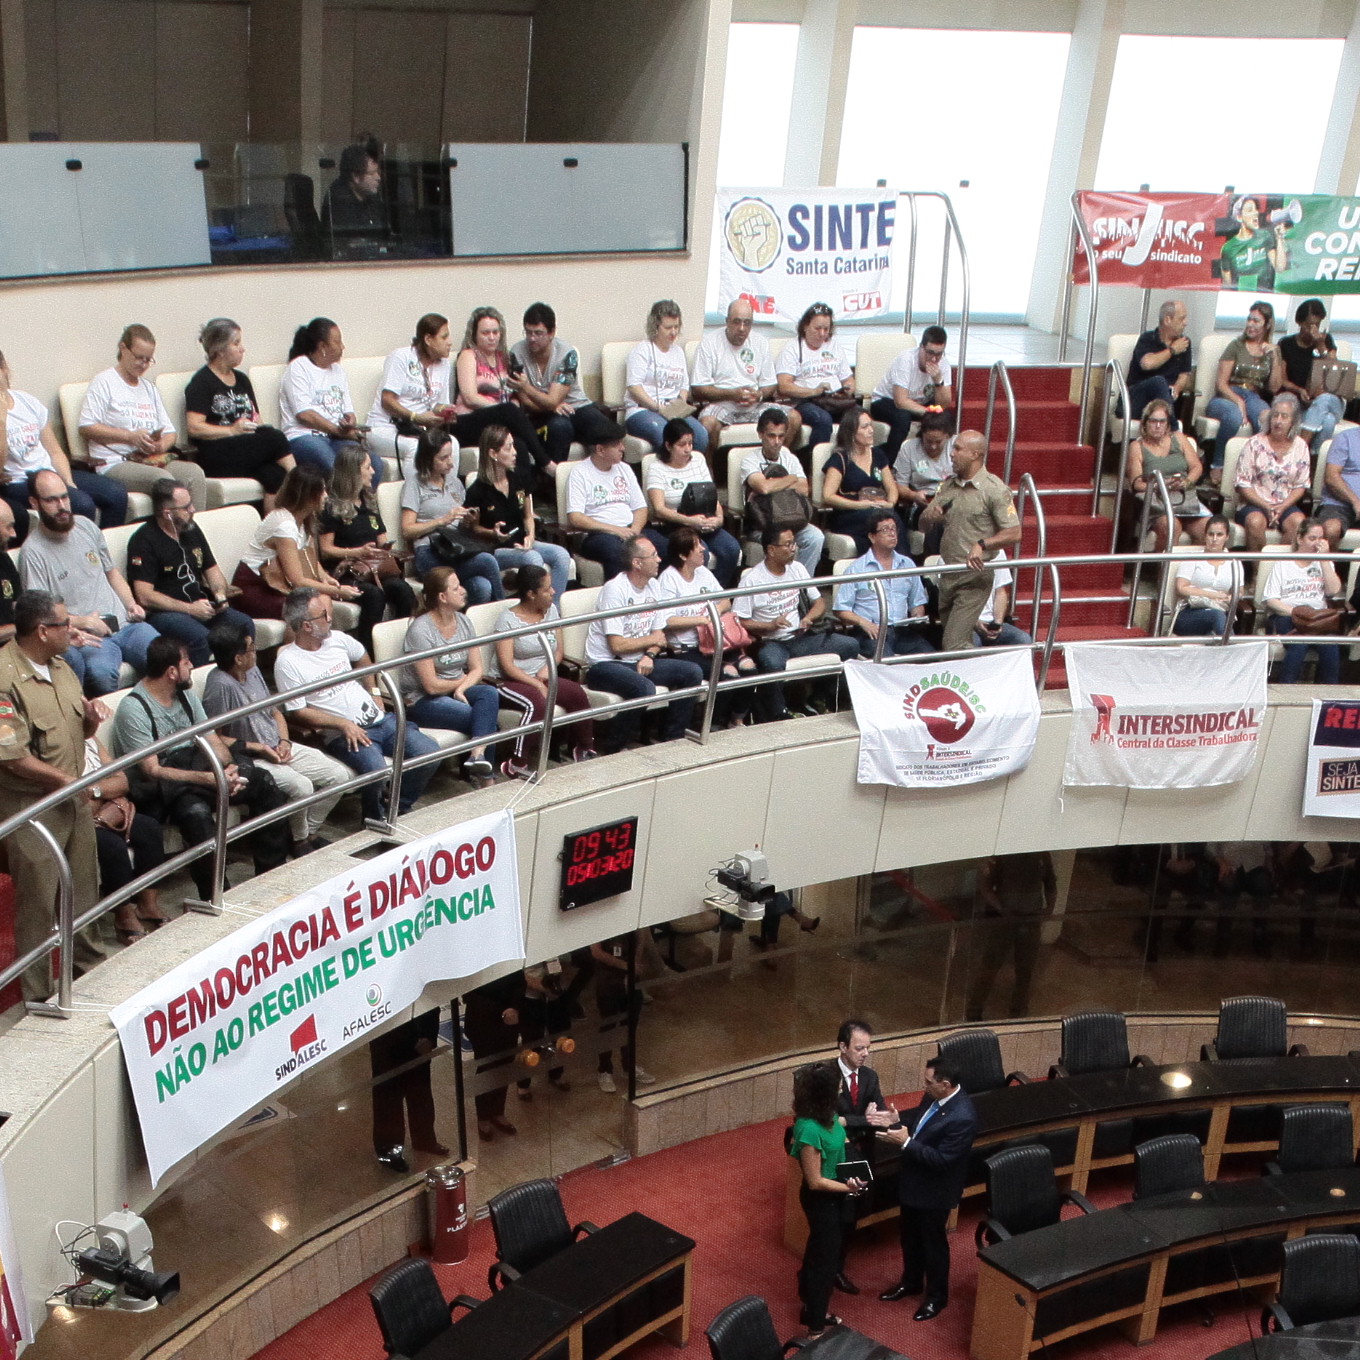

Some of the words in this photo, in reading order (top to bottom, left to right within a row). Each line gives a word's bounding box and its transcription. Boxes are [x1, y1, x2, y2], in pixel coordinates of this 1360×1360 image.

[787, 200, 896, 252] SINTE
[786, 256, 828, 275] Santa
[1102, 250, 1122, 259] seu
[1150, 249, 1202, 264] sindicato
[843, 292, 881, 311] CUT
[1117, 708, 1259, 735] INTERSINDICAL
[1117, 737, 1151, 749] Central
[1152, 737, 1164, 748] da
[1166, 736, 1196, 747] Classe
[1327, 761, 1360, 778] SEJA
[573, 832, 601, 862] 09
[605, 823, 632, 849] 43
[143, 908, 342, 1058] DEMOCRACIA
[343, 880, 365, 934] É
[368, 836, 496, 922] DIÁLOGO
[155, 1038, 207, 1103] NÃO
[212, 1016, 244, 1064] AO
[248, 960, 340, 1038] REGIME
[342, 941, 376, 980] DE
[378, 883, 495, 959] URGÊNCIA
[343, 1001, 391, 1041] AFALESC
[275, 1039, 327, 1081] SINDALESC
